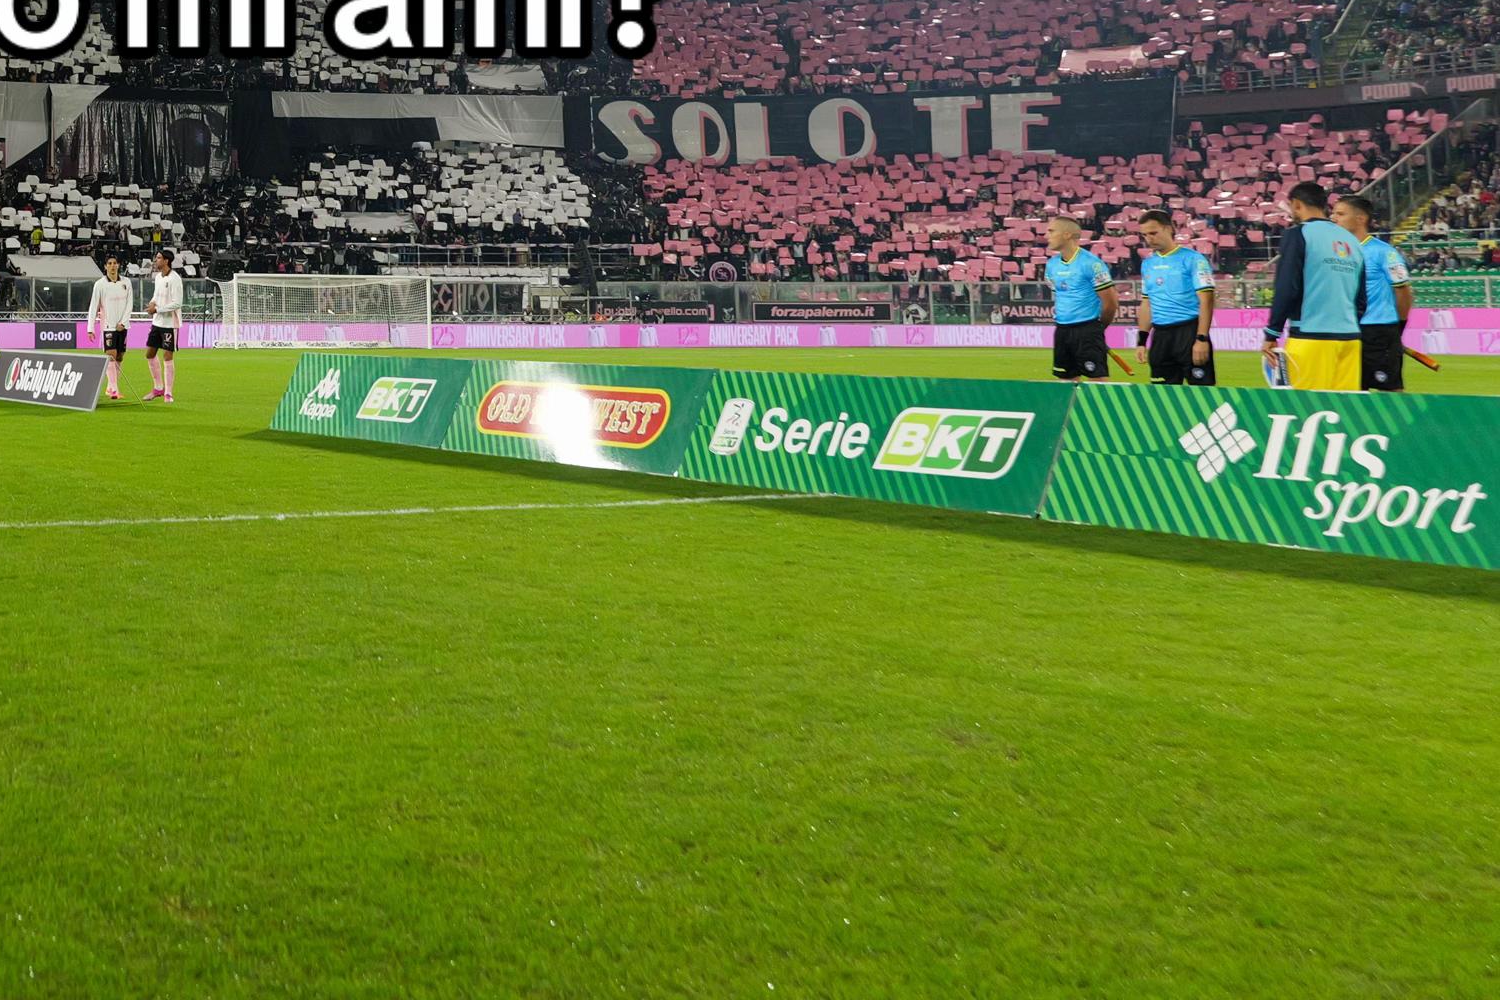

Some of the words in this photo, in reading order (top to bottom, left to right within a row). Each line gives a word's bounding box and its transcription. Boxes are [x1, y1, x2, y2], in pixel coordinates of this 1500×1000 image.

[913, 92, 1061, 159] TE
[770, 305, 875, 319] forzapalermo.it
[39, 330, 73, 342] 00:00
[465, 326, 535, 347] ANNIVERSARY
[538, 326, 565, 347] PACK
[708, 326, 772, 346] ANNIVERSARY
[774, 326, 799, 345] PACK
[933, 327, 1006, 346] ANNIVERSARY
[1011, 327, 1043, 346] PACK
[299, 397, 337, 420] Kappa
[364, 387, 428, 413] BKT
[487, 391, 532, 424] OLD
[754, 407, 870, 459] Serie
[897, 422, 1018, 464] BKT
[1252, 410, 1390, 482] Ifis
[1302, 479, 1488, 538] sport
